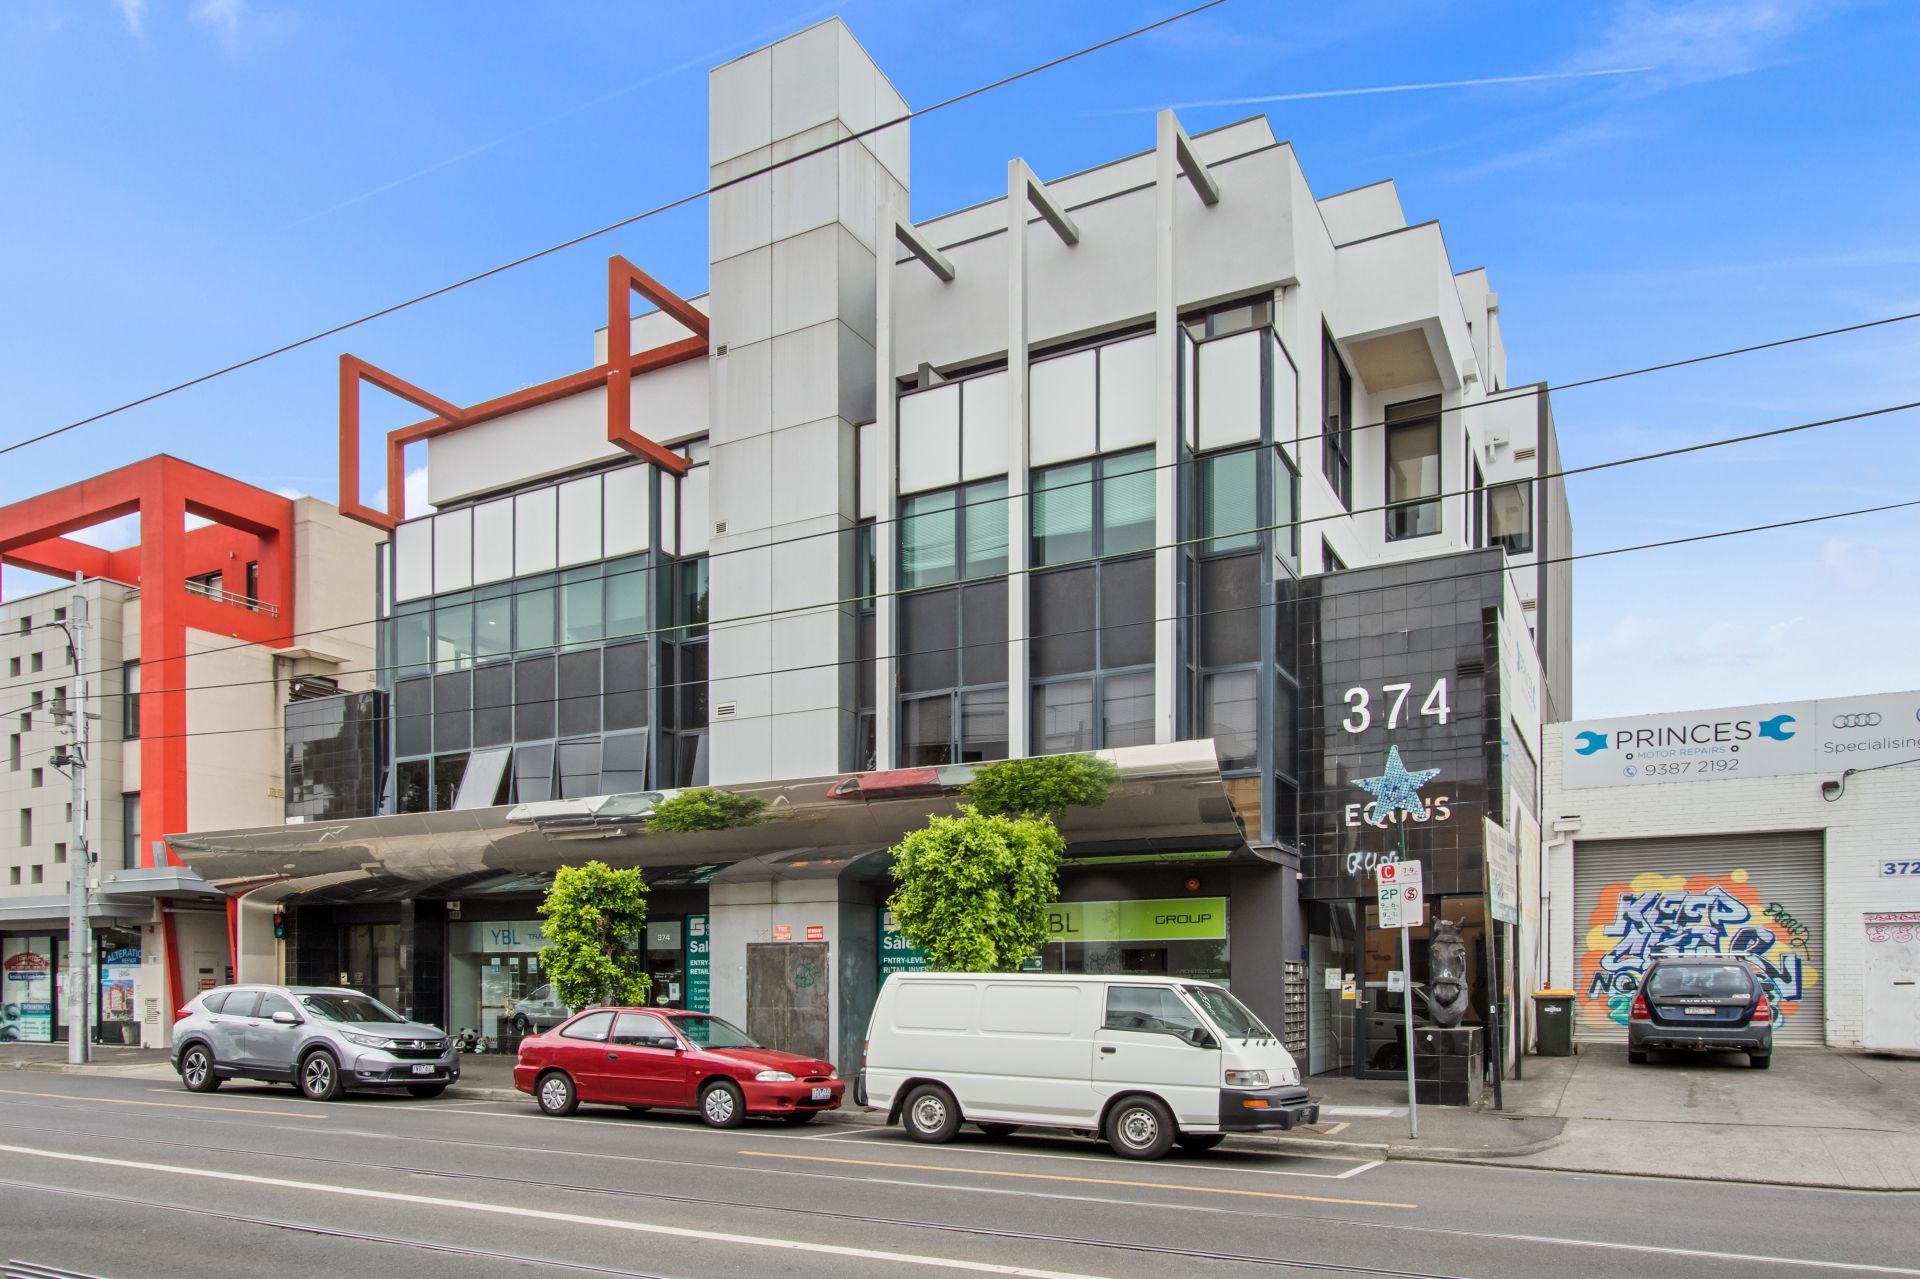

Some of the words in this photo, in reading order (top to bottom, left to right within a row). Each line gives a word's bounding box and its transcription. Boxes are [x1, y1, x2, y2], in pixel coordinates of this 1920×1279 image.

[1342, 677, 1451, 734] 374
[1616, 721, 1752, 750] PRINCES
[1637, 750, 1677, 760] MOTOR
[1679, 746, 1726, 757] REPAIRS
[1823, 736, 1920, 755] Specialisin
[1645, 762, 1691, 776] 9387
[1697, 758, 1740, 773] 2192
[1883, 861, 1920, 875] 372
[1380, 888, 1398, 900] 2P
[1049, 913, 1079, 933] BL
[1155, 913, 1211, 925] GROUP
[491, 929, 520, 945] YBL
